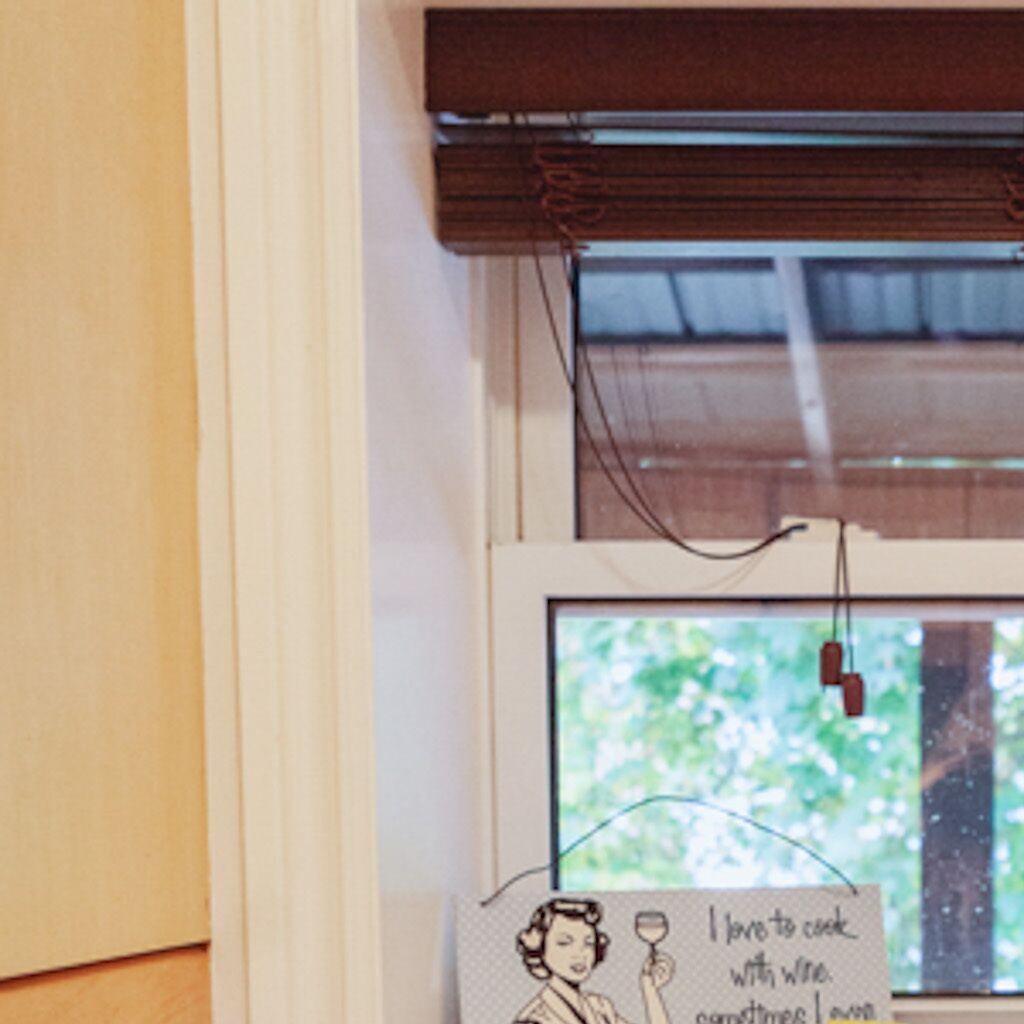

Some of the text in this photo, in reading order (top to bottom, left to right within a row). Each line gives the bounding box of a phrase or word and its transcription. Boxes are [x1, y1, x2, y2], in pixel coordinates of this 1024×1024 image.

[724, 912, 769, 946] love
[768, 908, 796, 939] to
[802, 906, 858, 940] cook
[730, 951, 776, 989] with
